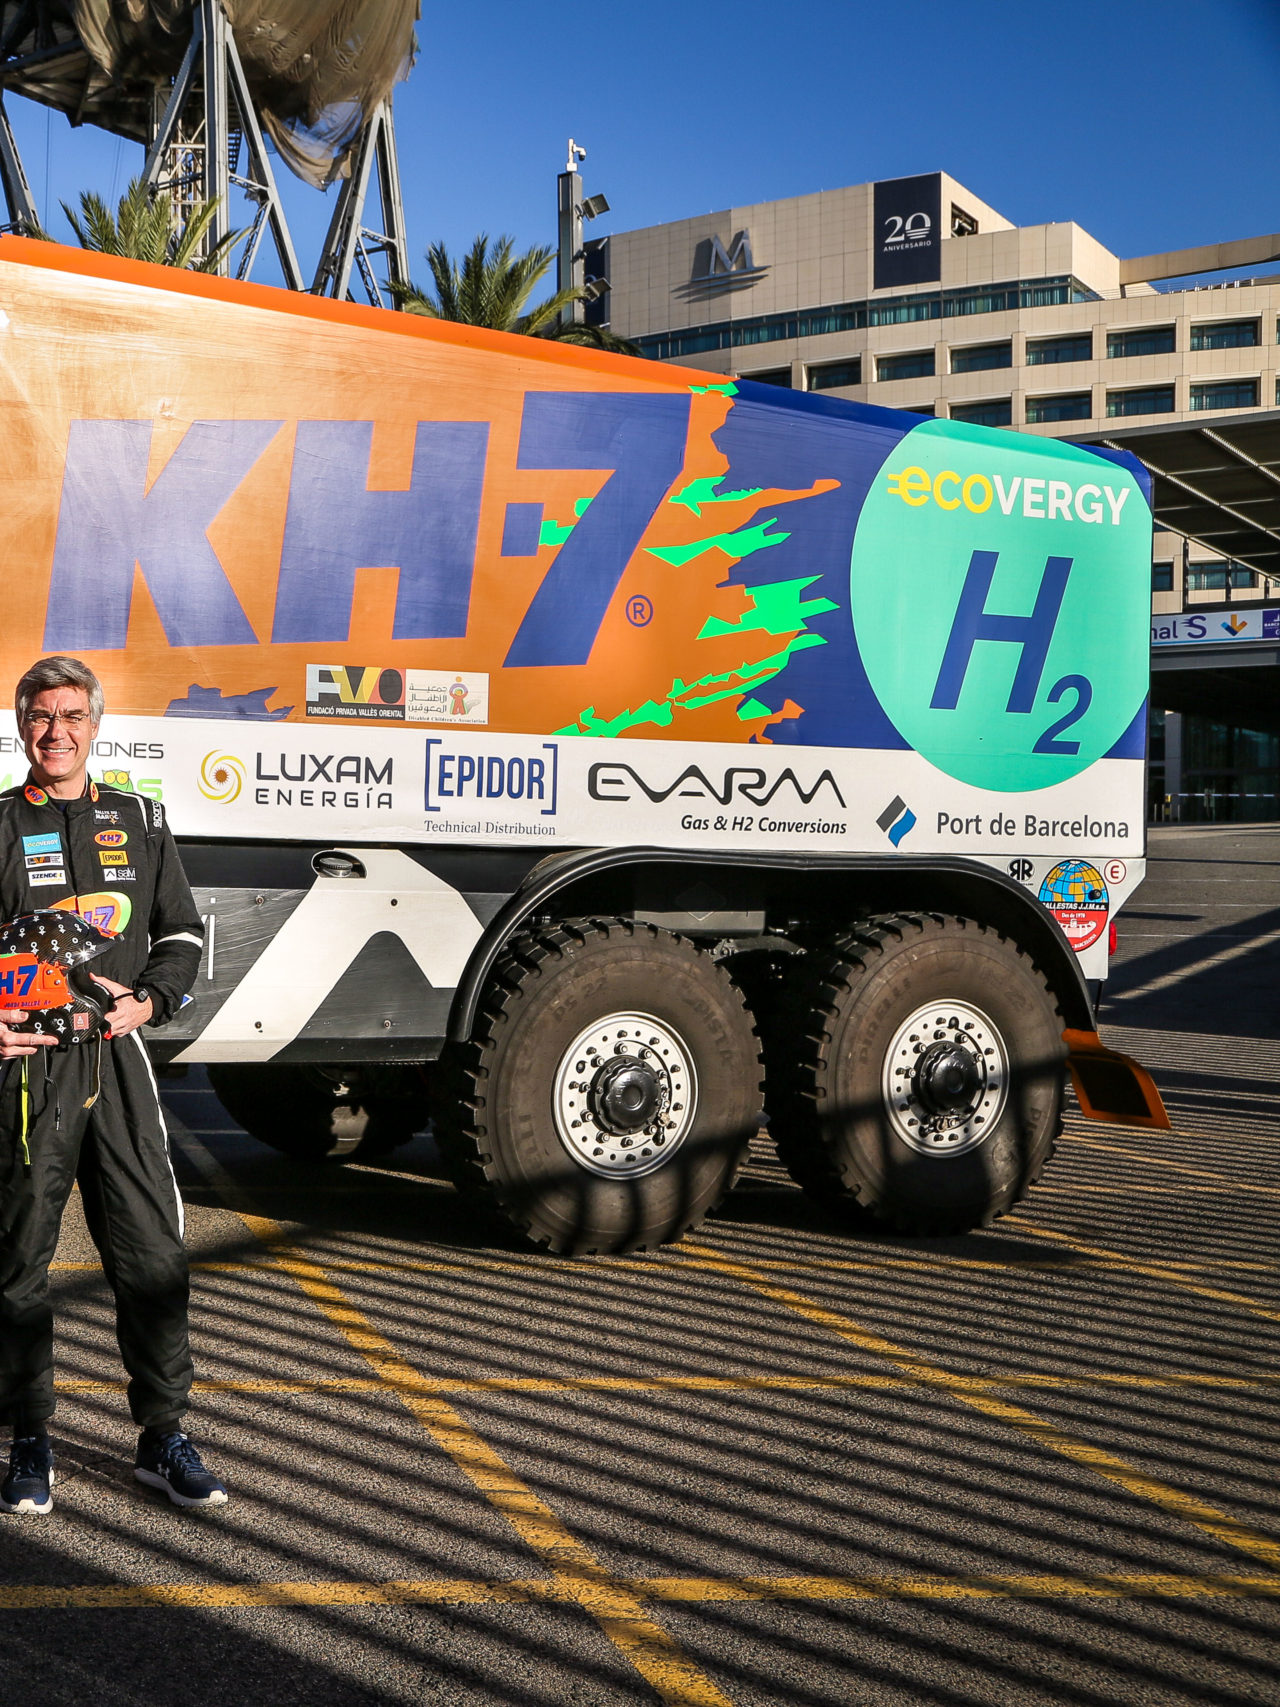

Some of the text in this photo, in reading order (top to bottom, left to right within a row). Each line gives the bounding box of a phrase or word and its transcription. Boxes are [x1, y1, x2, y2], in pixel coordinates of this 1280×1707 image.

[883, 240, 931, 252] ANIVERSARIO
[335, 707, 357, 716] PRIVADA
[379, 709, 404, 718] ORIENTAL
[256, 751, 394, 785] LUXAM
[437, 754, 546, 800] EPIDOR
[255, 787, 393, 810] ENERGÍA
[424, 819, 557, 835] Technical Distribution
[680, 815, 847, 835] Gas & H2 Conversions
[936, 811, 1129, 839] Port de Barcelona
